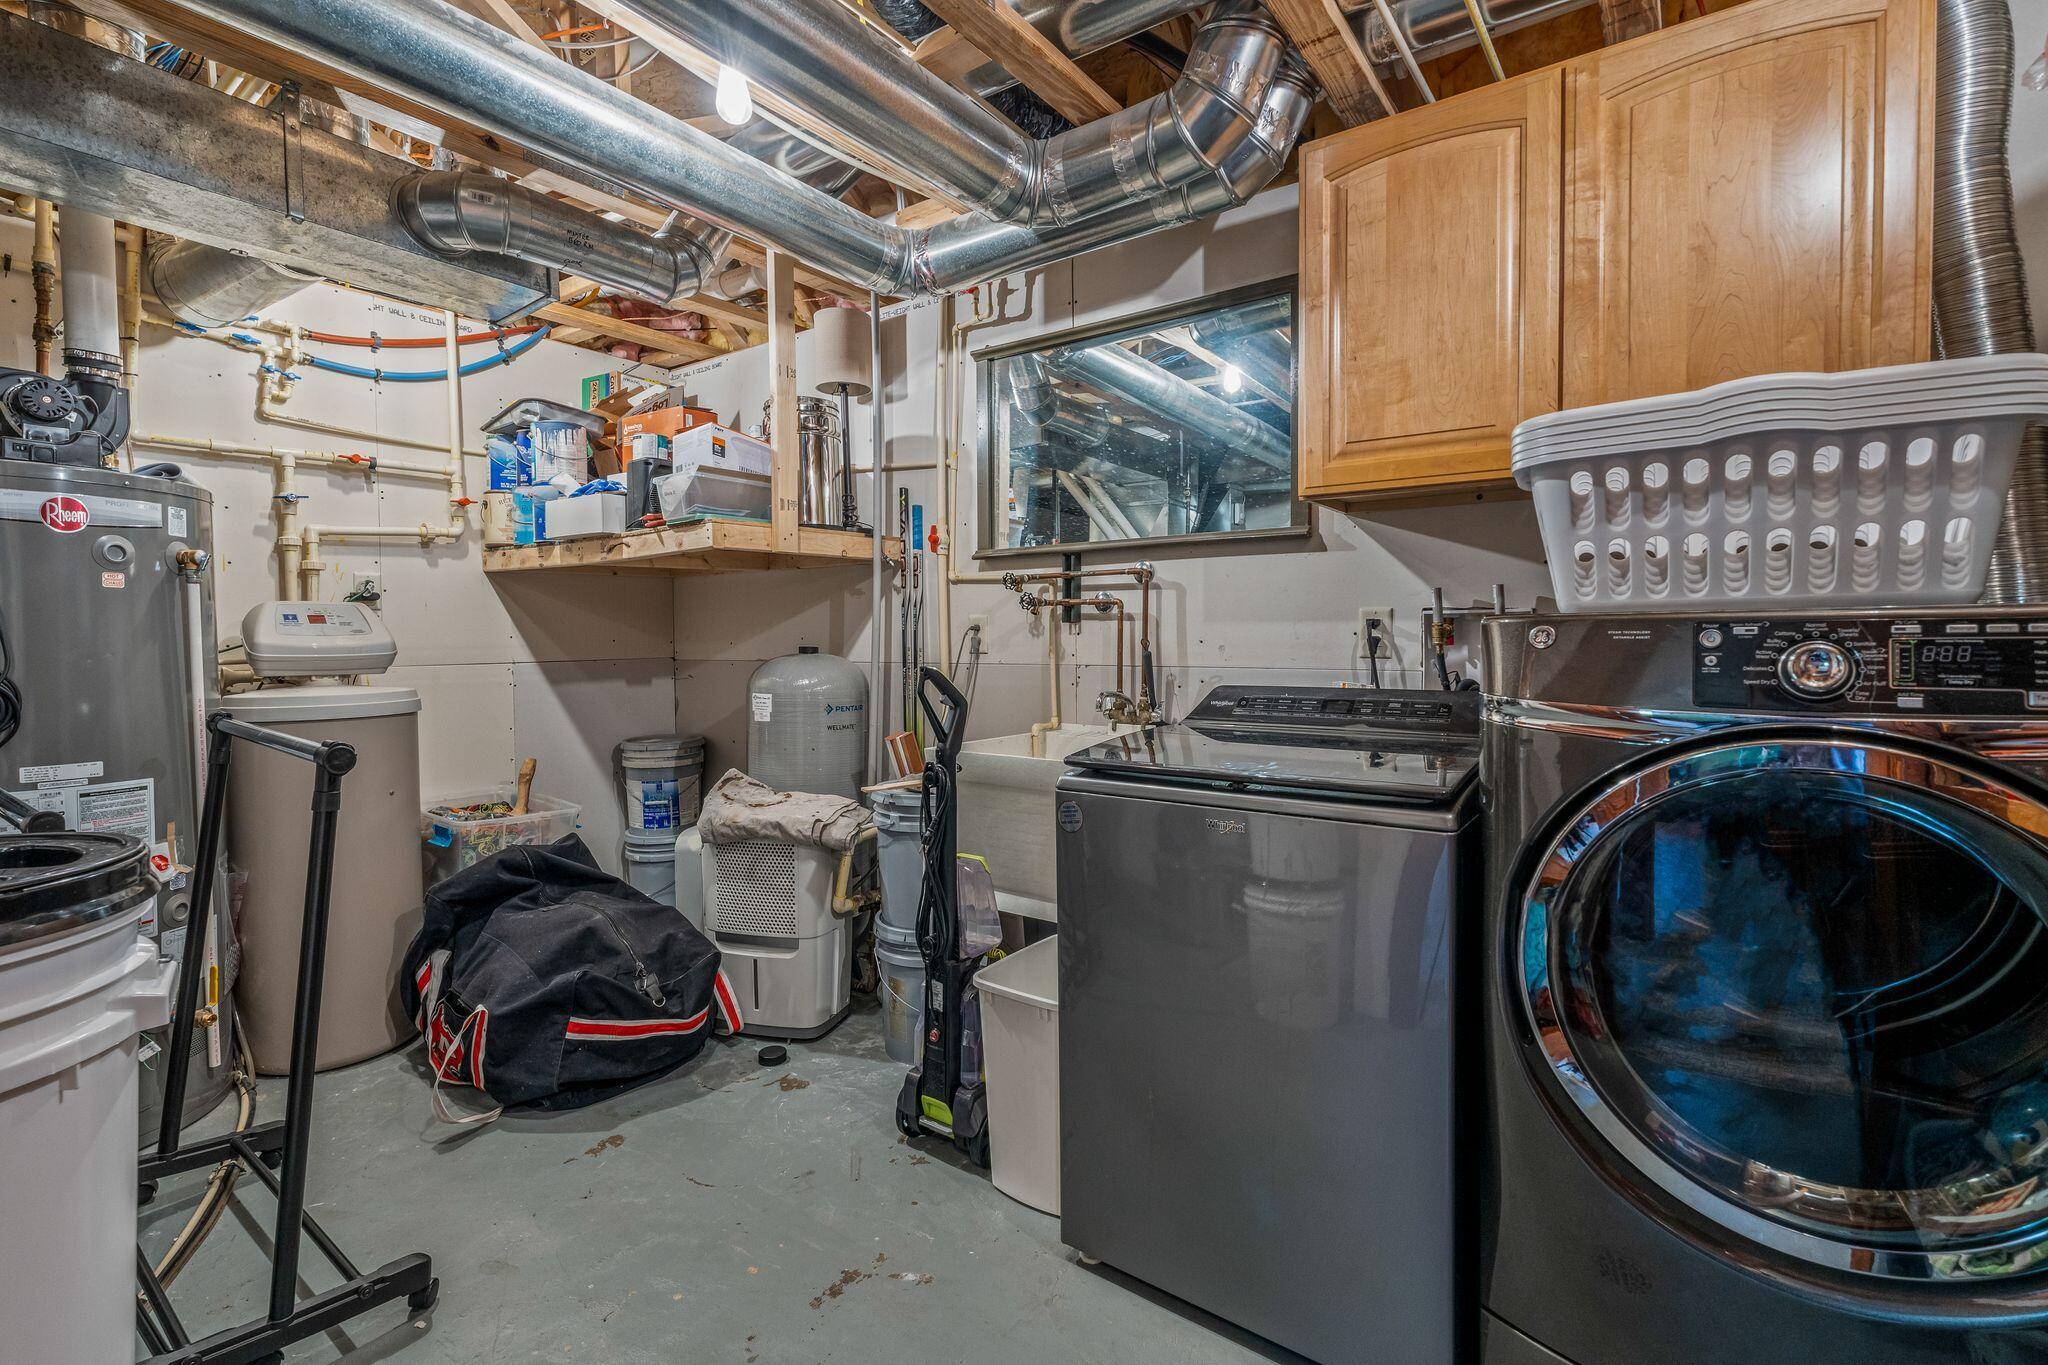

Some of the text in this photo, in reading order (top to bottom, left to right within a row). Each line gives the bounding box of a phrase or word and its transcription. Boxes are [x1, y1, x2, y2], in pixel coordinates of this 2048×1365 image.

[913, 301, 925, 309] WALL
[389, 307, 407, 318] WALL
[419, 314, 446, 327] CEILIN
[46, 496, 87, 528] Rheem
[835, 704, 864, 713] PENTAIR
[826, 723, 855, 731] WELLMATE
